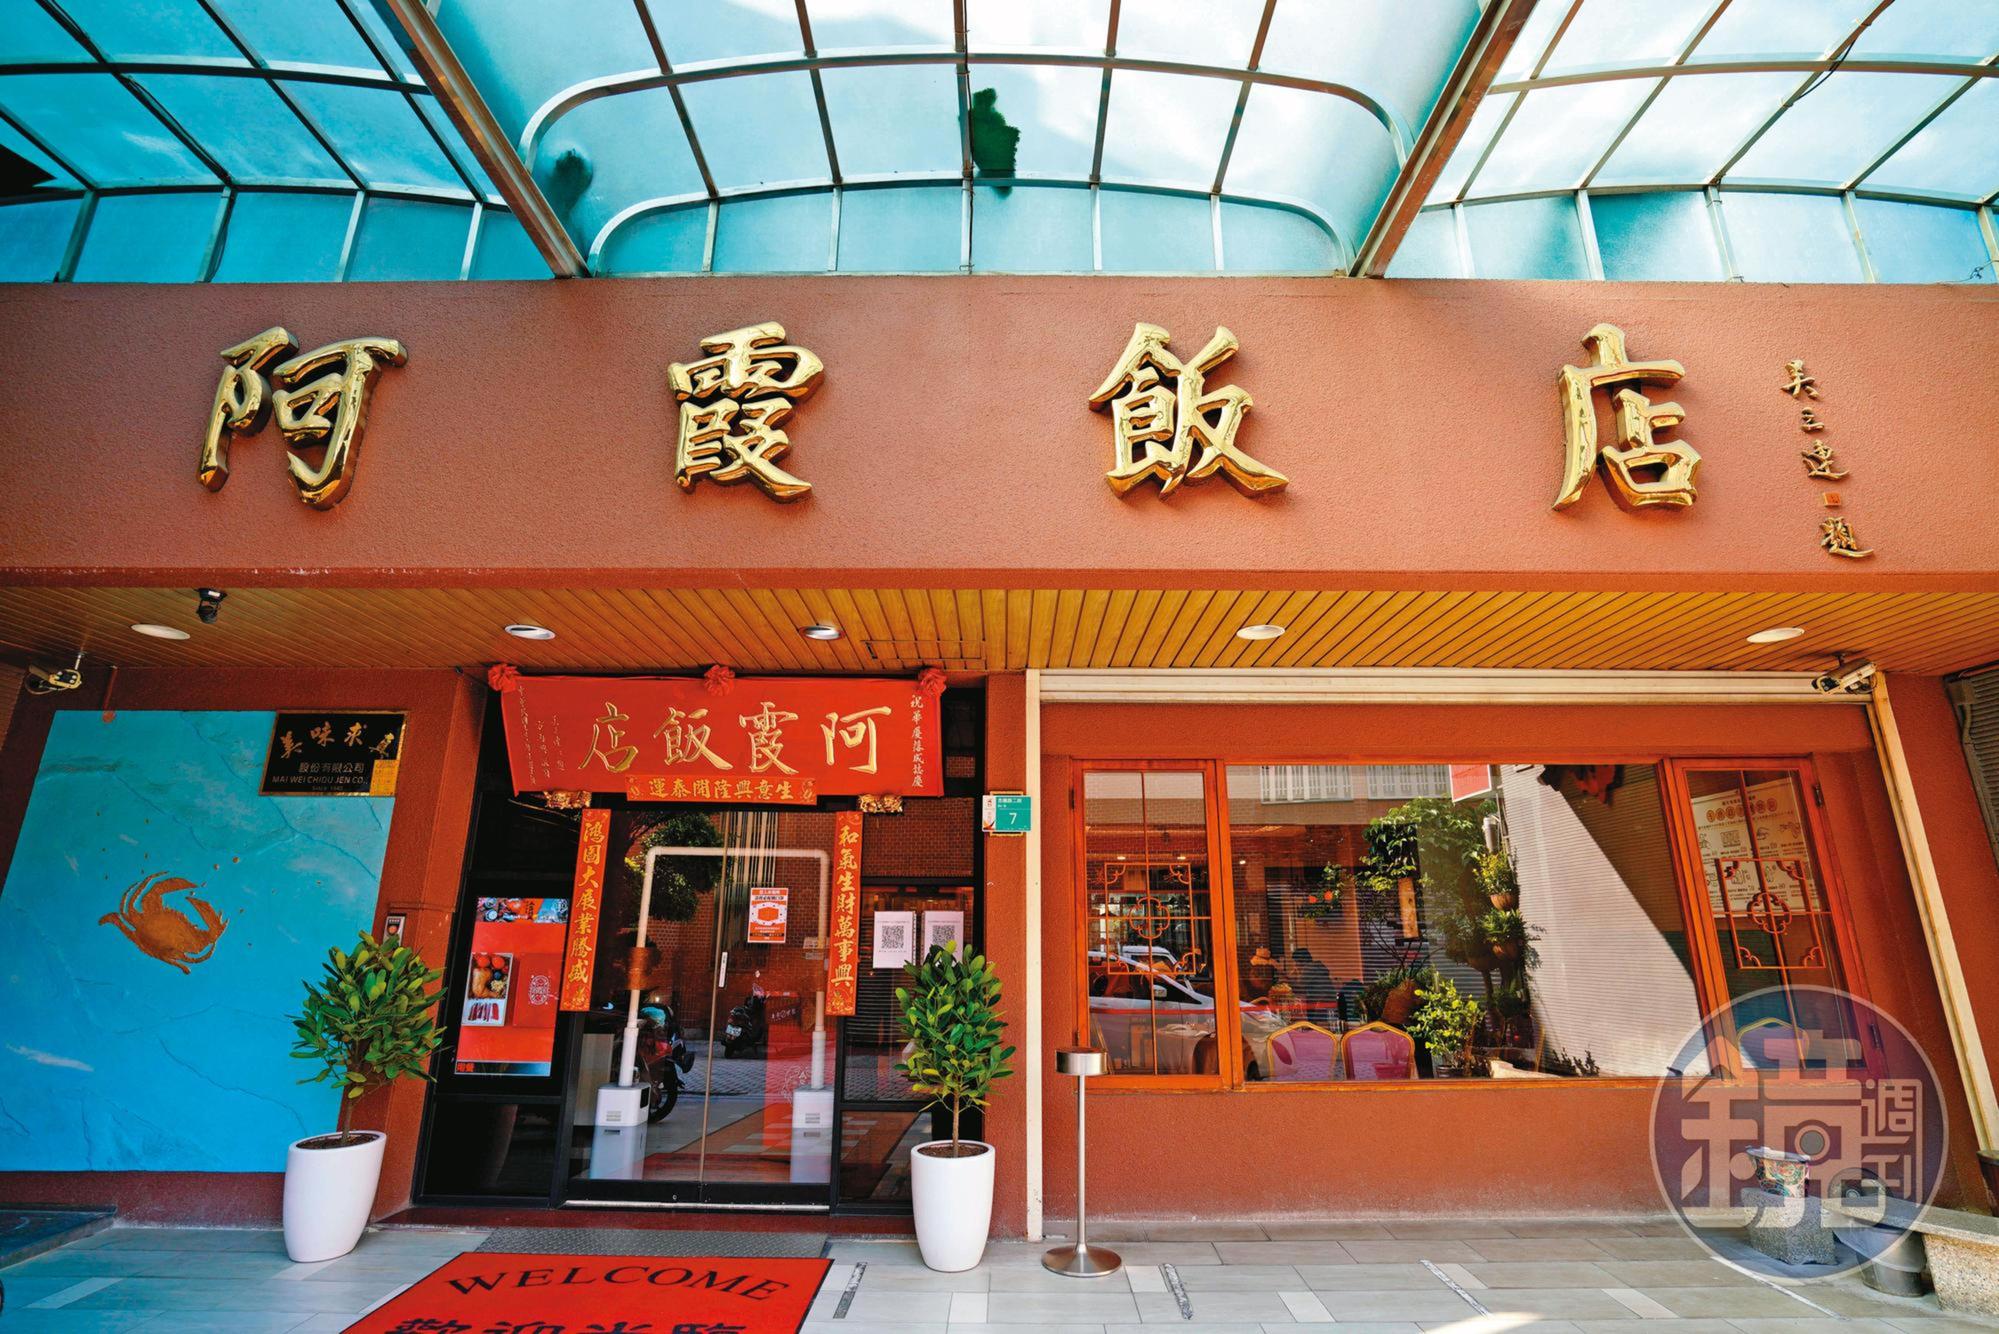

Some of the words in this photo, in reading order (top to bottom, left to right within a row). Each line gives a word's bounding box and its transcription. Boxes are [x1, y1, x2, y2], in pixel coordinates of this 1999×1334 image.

[197, 320, 1702, 511] 阿霞飯店
[577, 700, 892, 776] 阿霞飯店
[290, 775, 306, 784] WEI
[335, 775, 350, 784] JEN
[1009, 812, 1017, 825] 7
[444, 1265, 790, 1301] WELCOME
